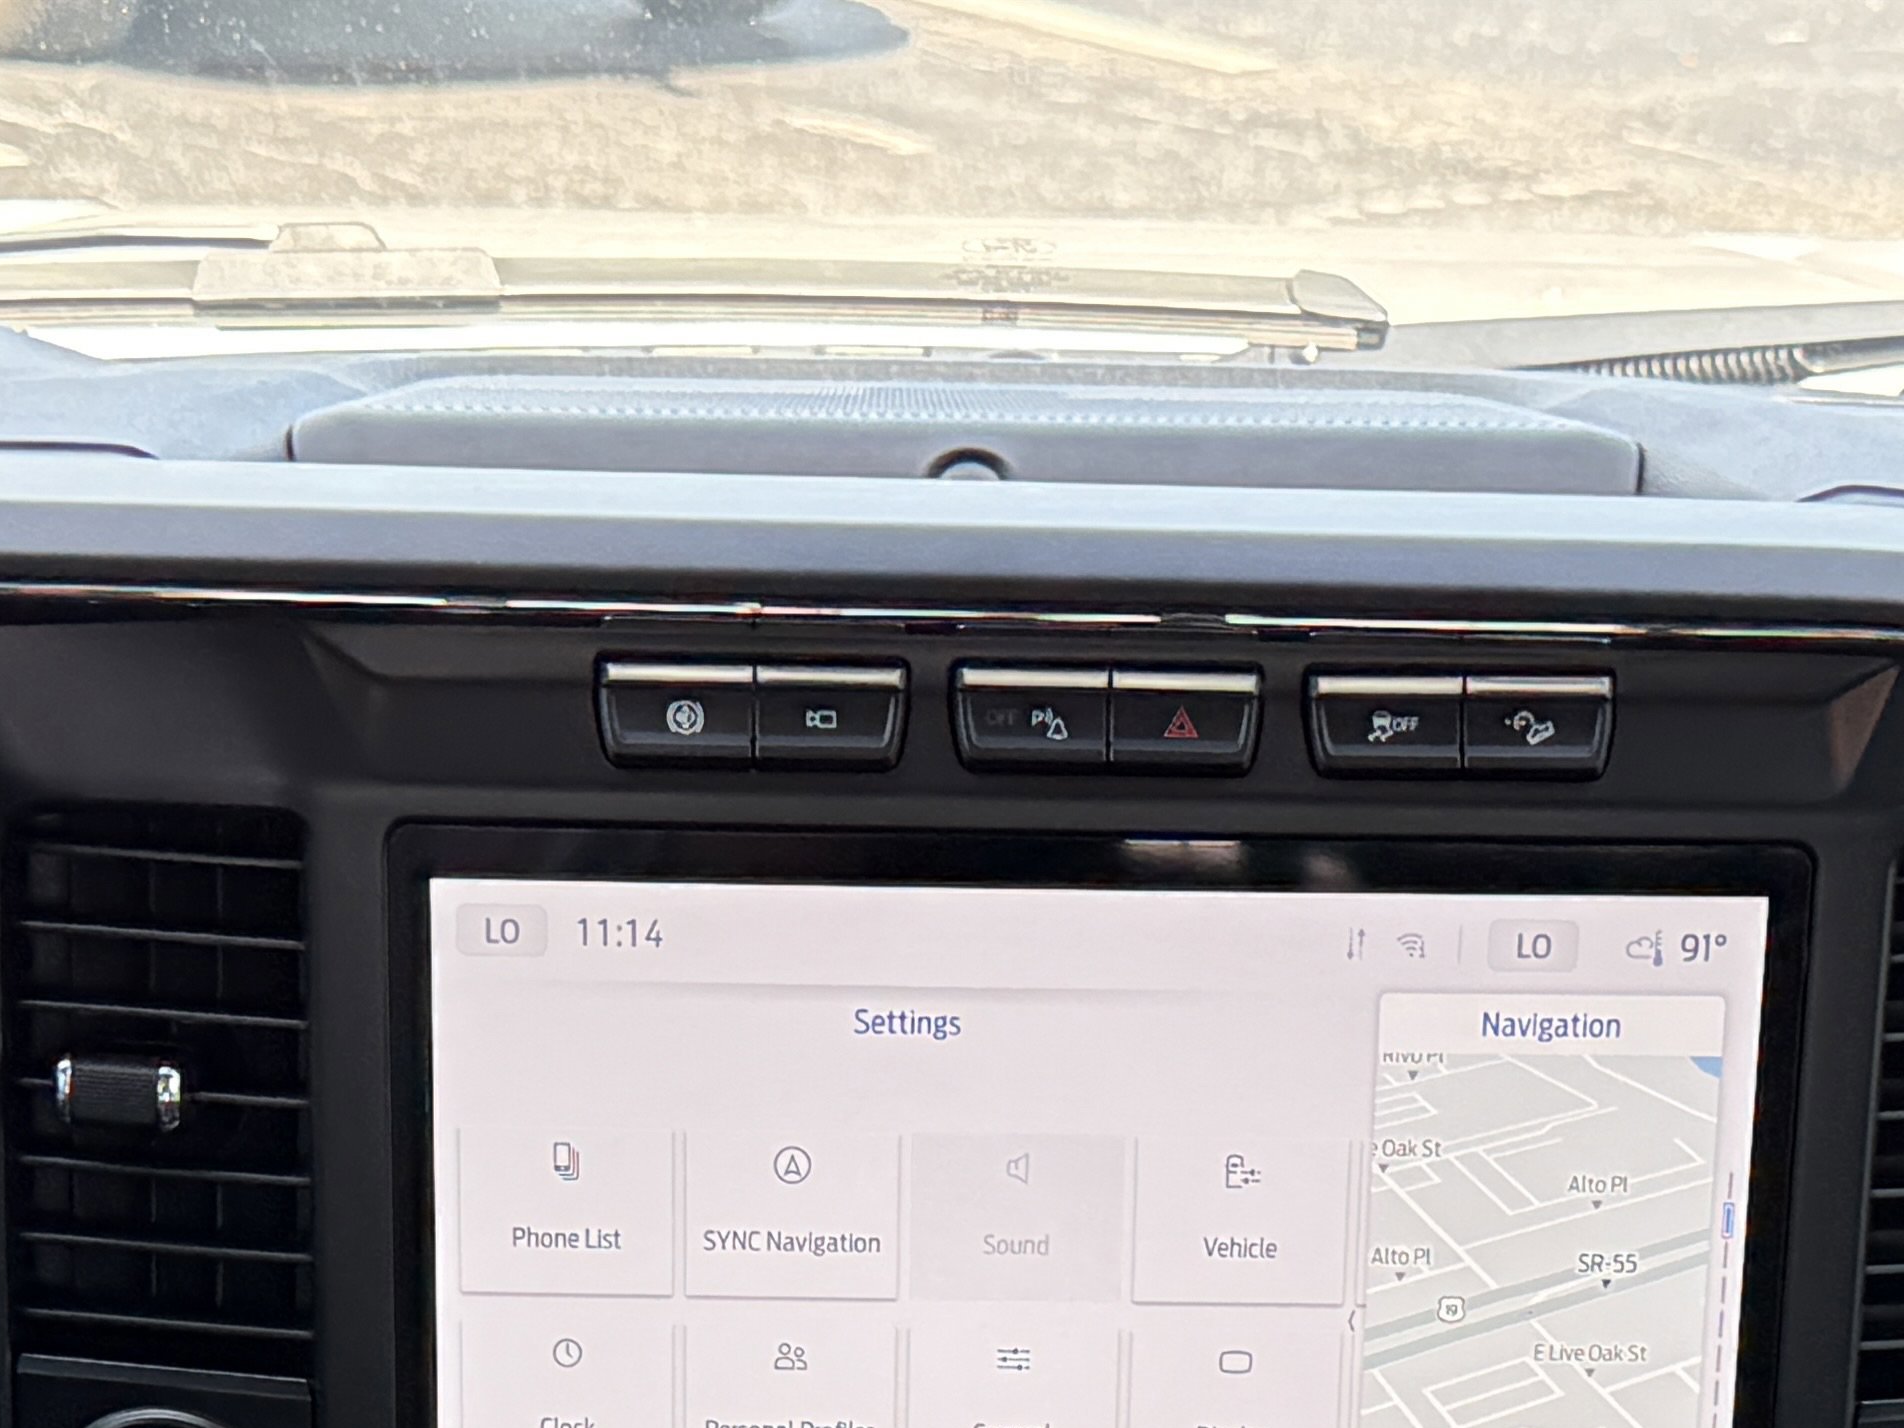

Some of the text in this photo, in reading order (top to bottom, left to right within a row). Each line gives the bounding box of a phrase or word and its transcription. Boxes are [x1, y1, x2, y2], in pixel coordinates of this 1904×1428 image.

[1392, 716, 1421, 733] OFF
[484, 917, 521, 945] LO
[576, 917, 664, 949] 11:14
[1516, 933, 1552, 959] LO
[1680, 933, 1729, 962] 91°
[853, 1008, 962, 1040] Settings
[1481, 1012, 1622, 1043] Navigation
[1382, 1140, 1418, 1157] Oak
[1421, 1140, 1442, 1158] St
[1567, 1175, 1628, 1194] Alto Pl
[512, 1226, 622, 1252] Phone List
[702, 1229, 882, 1257] SYNC Navigation
[982, 1233, 1050, 1257] Sound
[1203, 1236, 1278, 1260] Vehicle
[1371, 1247, 1431, 1266] Alto Pl
[1577, 1253, 1638, 1274] SR-55
[1534, 1344, 1647, 1362] E Live Oak St
